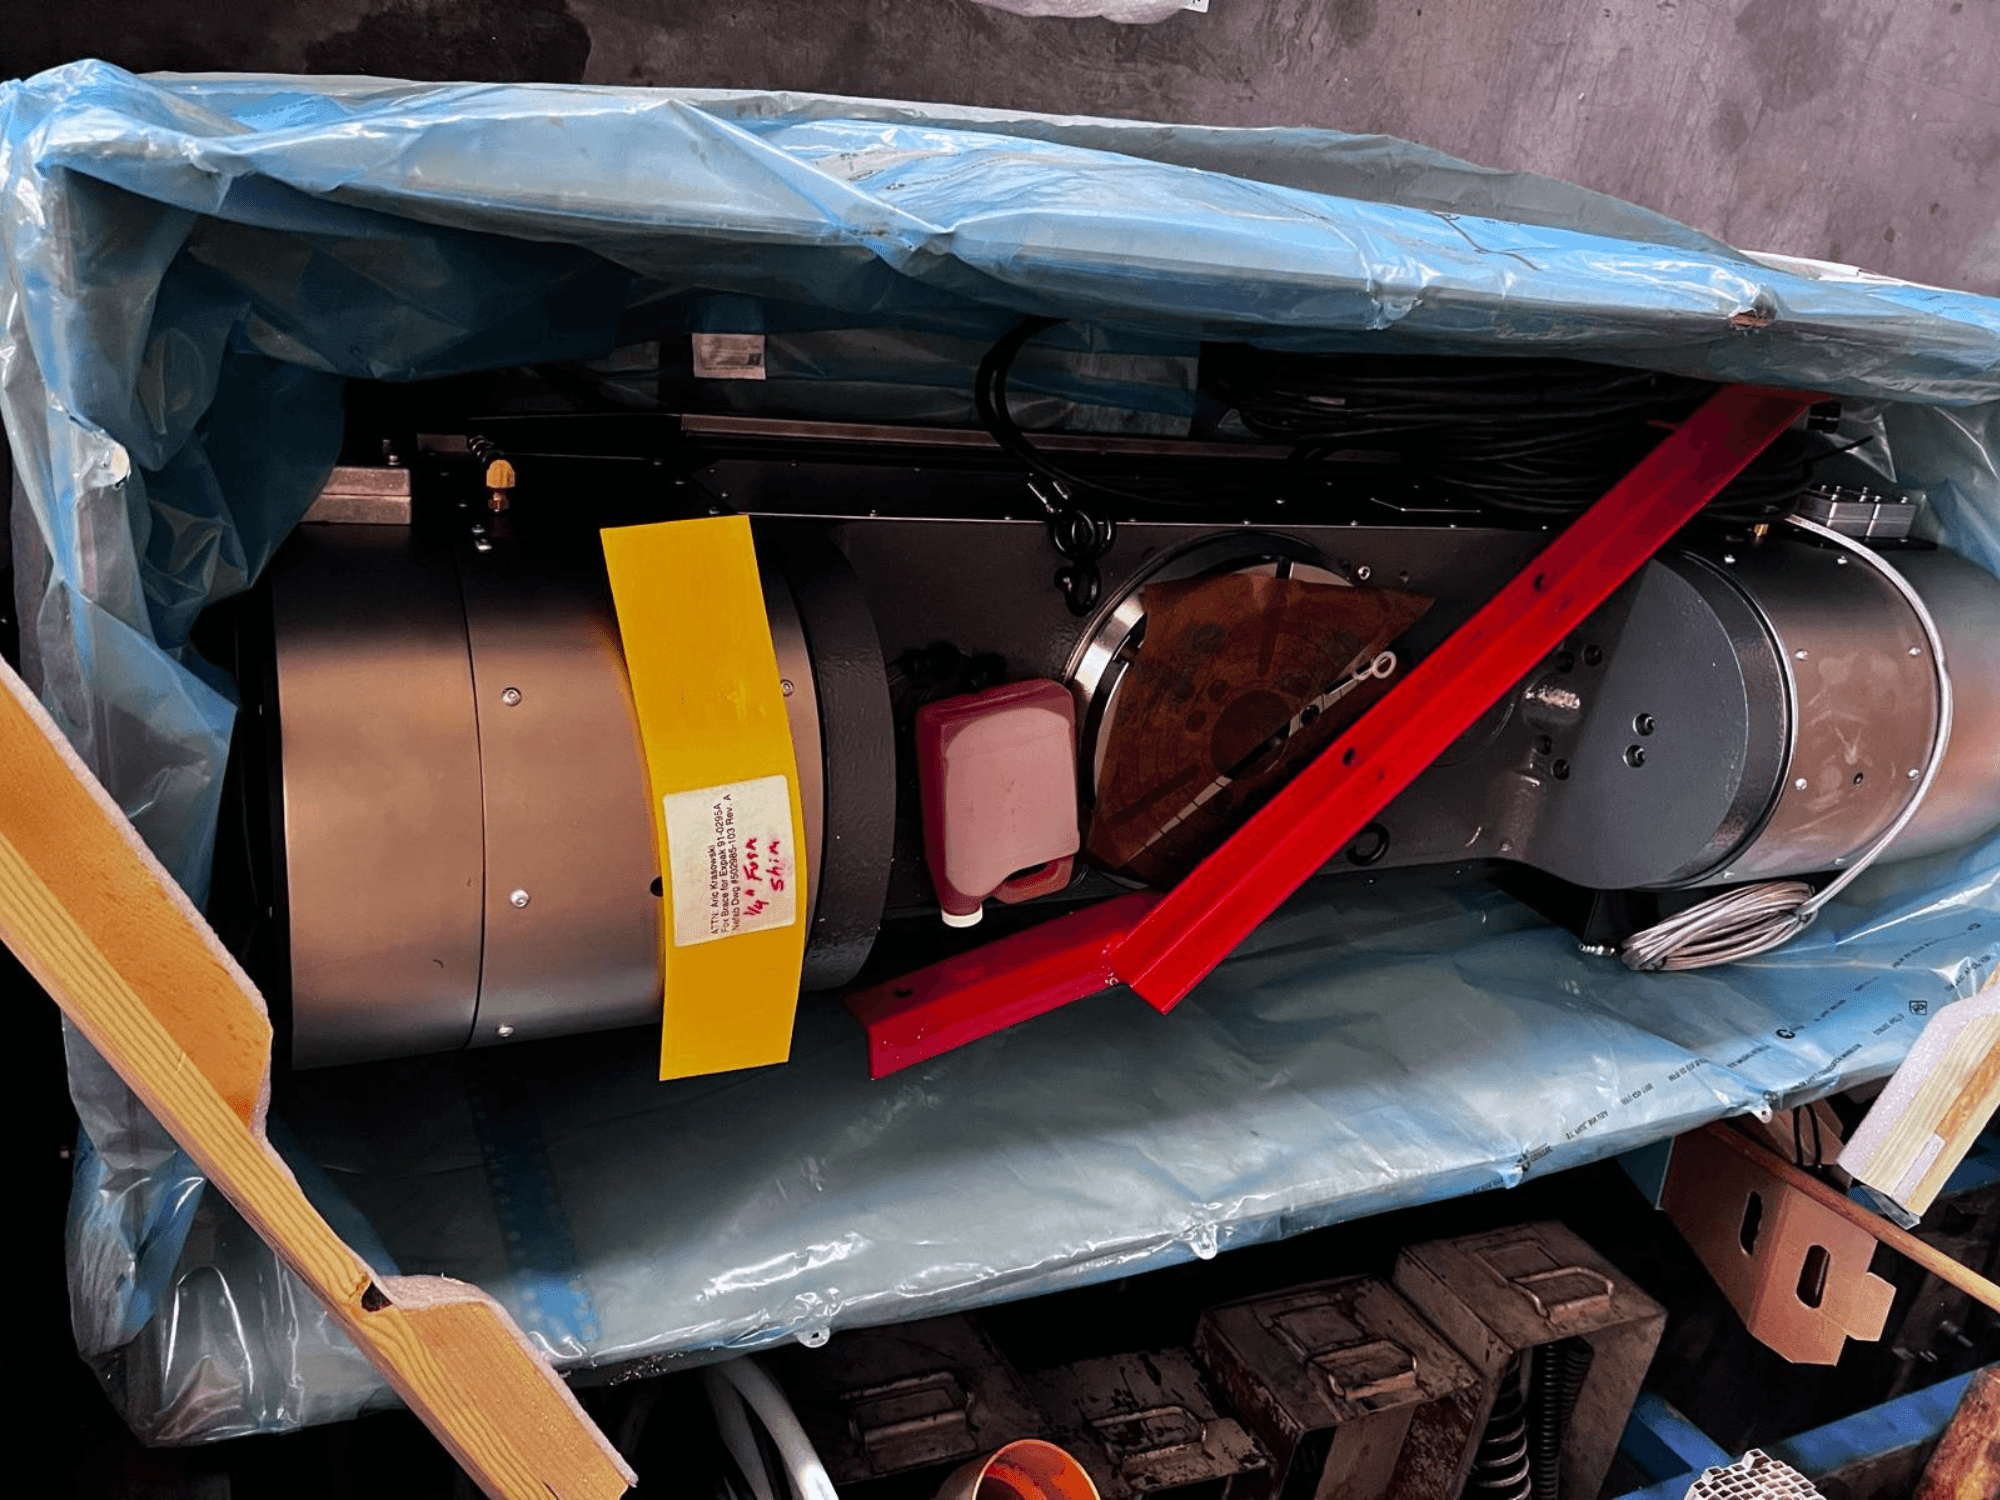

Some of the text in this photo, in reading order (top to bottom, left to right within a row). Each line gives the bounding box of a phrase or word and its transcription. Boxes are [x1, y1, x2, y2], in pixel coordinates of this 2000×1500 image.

[723, 793, 732, 801] A
[713, 802, 726, 847] 91-0295A
[725, 803, 734, 825] Rev.
[718, 849, 728, 877] Expak
[727, 827, 739, 884] #502985-103
[707, 845, 718, 890] Krasowski
[720, 879, 729, 891] for
[731, 886, 741, 906] Dwg
[711, 891, 719, 907] Aric
[721, 892, 729, 917] Brace
